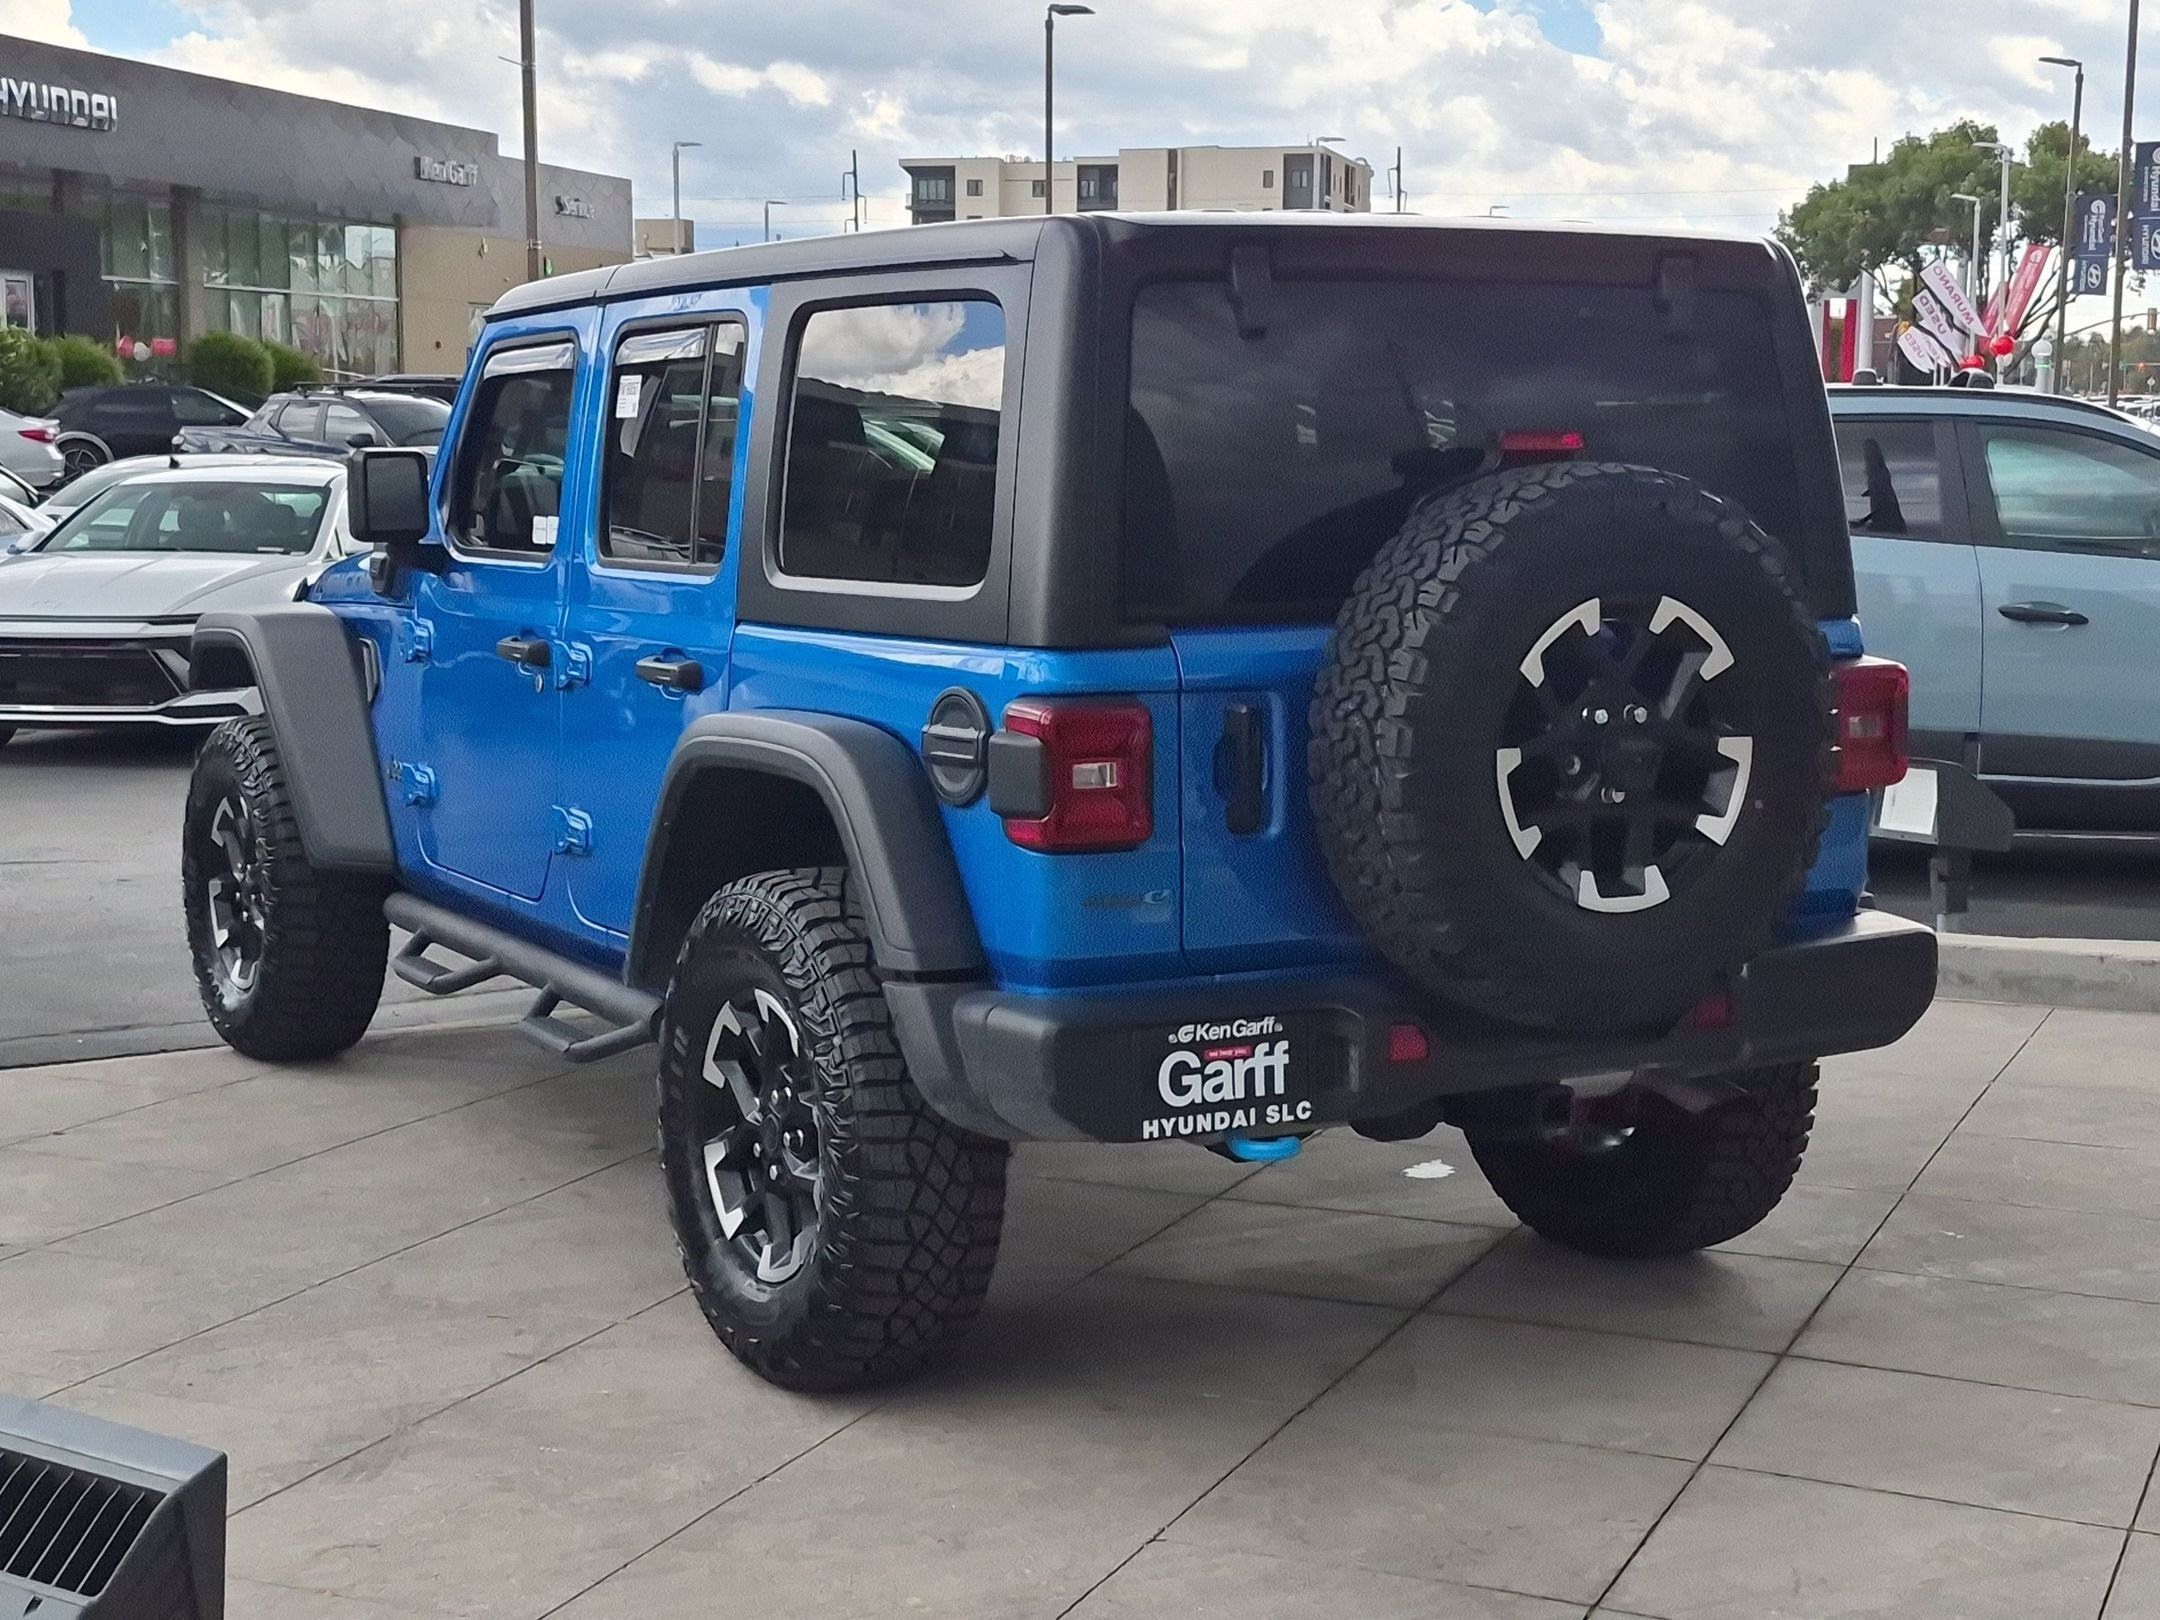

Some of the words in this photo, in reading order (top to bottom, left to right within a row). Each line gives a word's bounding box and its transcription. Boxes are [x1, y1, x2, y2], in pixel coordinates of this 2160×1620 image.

[1195, 1023, 1231, 1041] Ken
[1232, 1015, 1276, 1038] Garff
[1158, 1040, 1289, 1108] Garff
[1142, 1108, 1256, 1139] HYUNDAI
[1266, 1100, 1313, 1125] SLC
